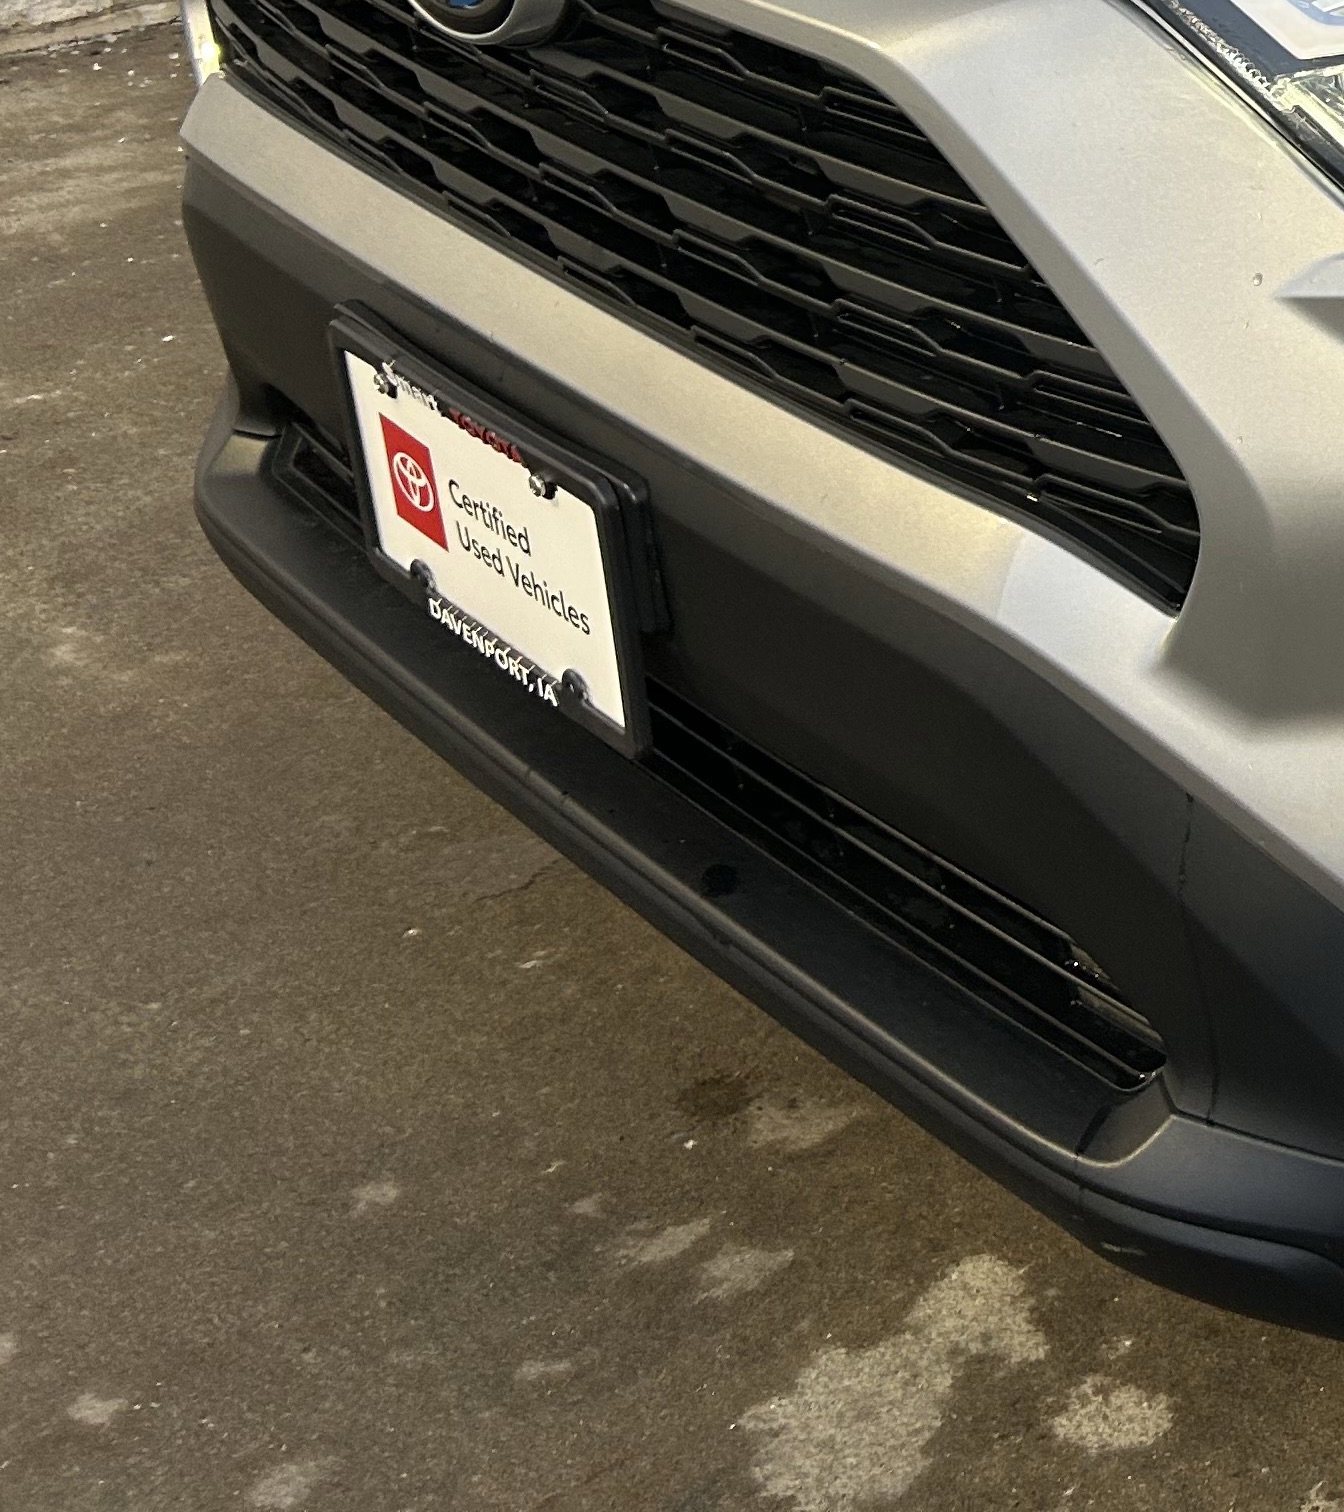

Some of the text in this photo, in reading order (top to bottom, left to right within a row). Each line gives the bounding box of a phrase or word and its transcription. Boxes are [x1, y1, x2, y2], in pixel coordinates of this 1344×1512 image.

[447, 478, 532, 558] Certified
[455, 520, 592, 636] Used Vehicles
[428, 597, 559, 707] DAVENPORT, IA
